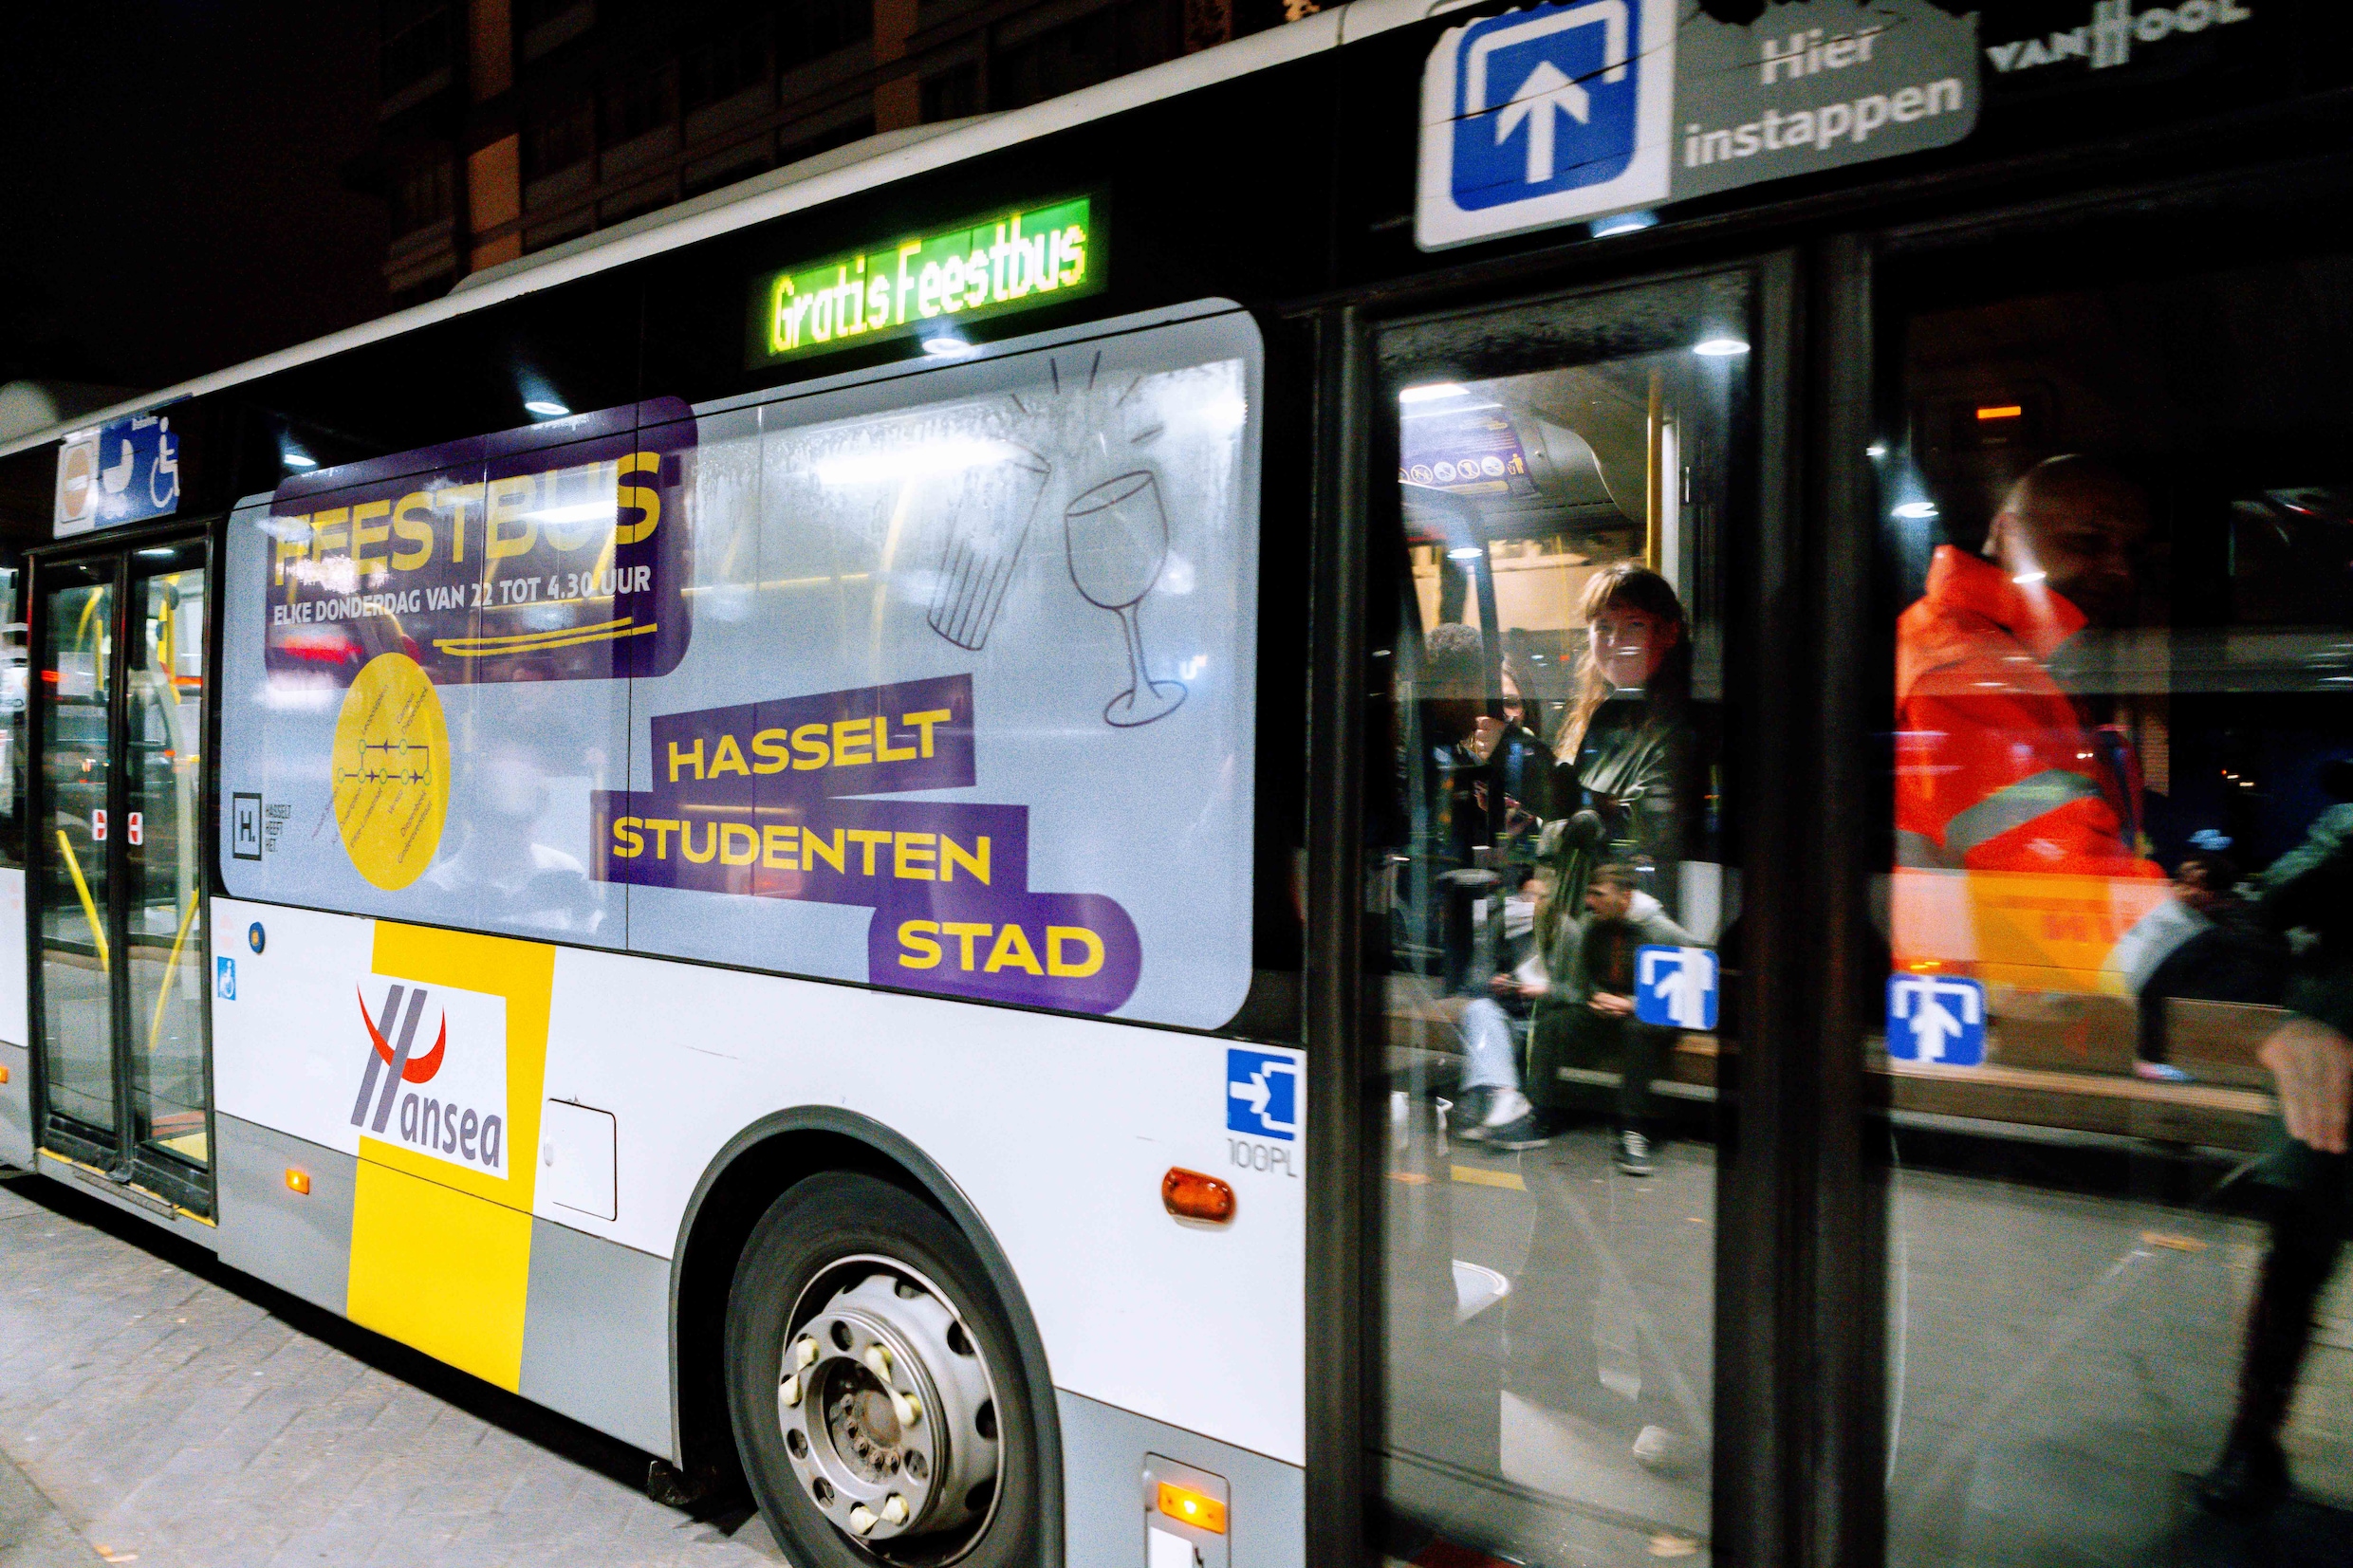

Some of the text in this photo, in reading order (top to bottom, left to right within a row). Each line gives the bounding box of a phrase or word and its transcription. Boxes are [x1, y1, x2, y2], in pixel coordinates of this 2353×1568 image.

[1758, 24, 1883, 84] Hier
[1683, 77, 1964, 168] instappen
[772, 213, 1087, 352] Gratis Feestbus
[274, 451, 661, 586] FEESTBUS
[273, 565, 653, 626] ELKE DONDERDAG VAN 22 TOT 4.30 UUR
[668, 708, 952, 784] HASSELT
[612, 815, 991, 887] STUDENTEN
[897, 918, 1106, 979] STAD
[1227, 1137, 1299, 1178] 100PL
